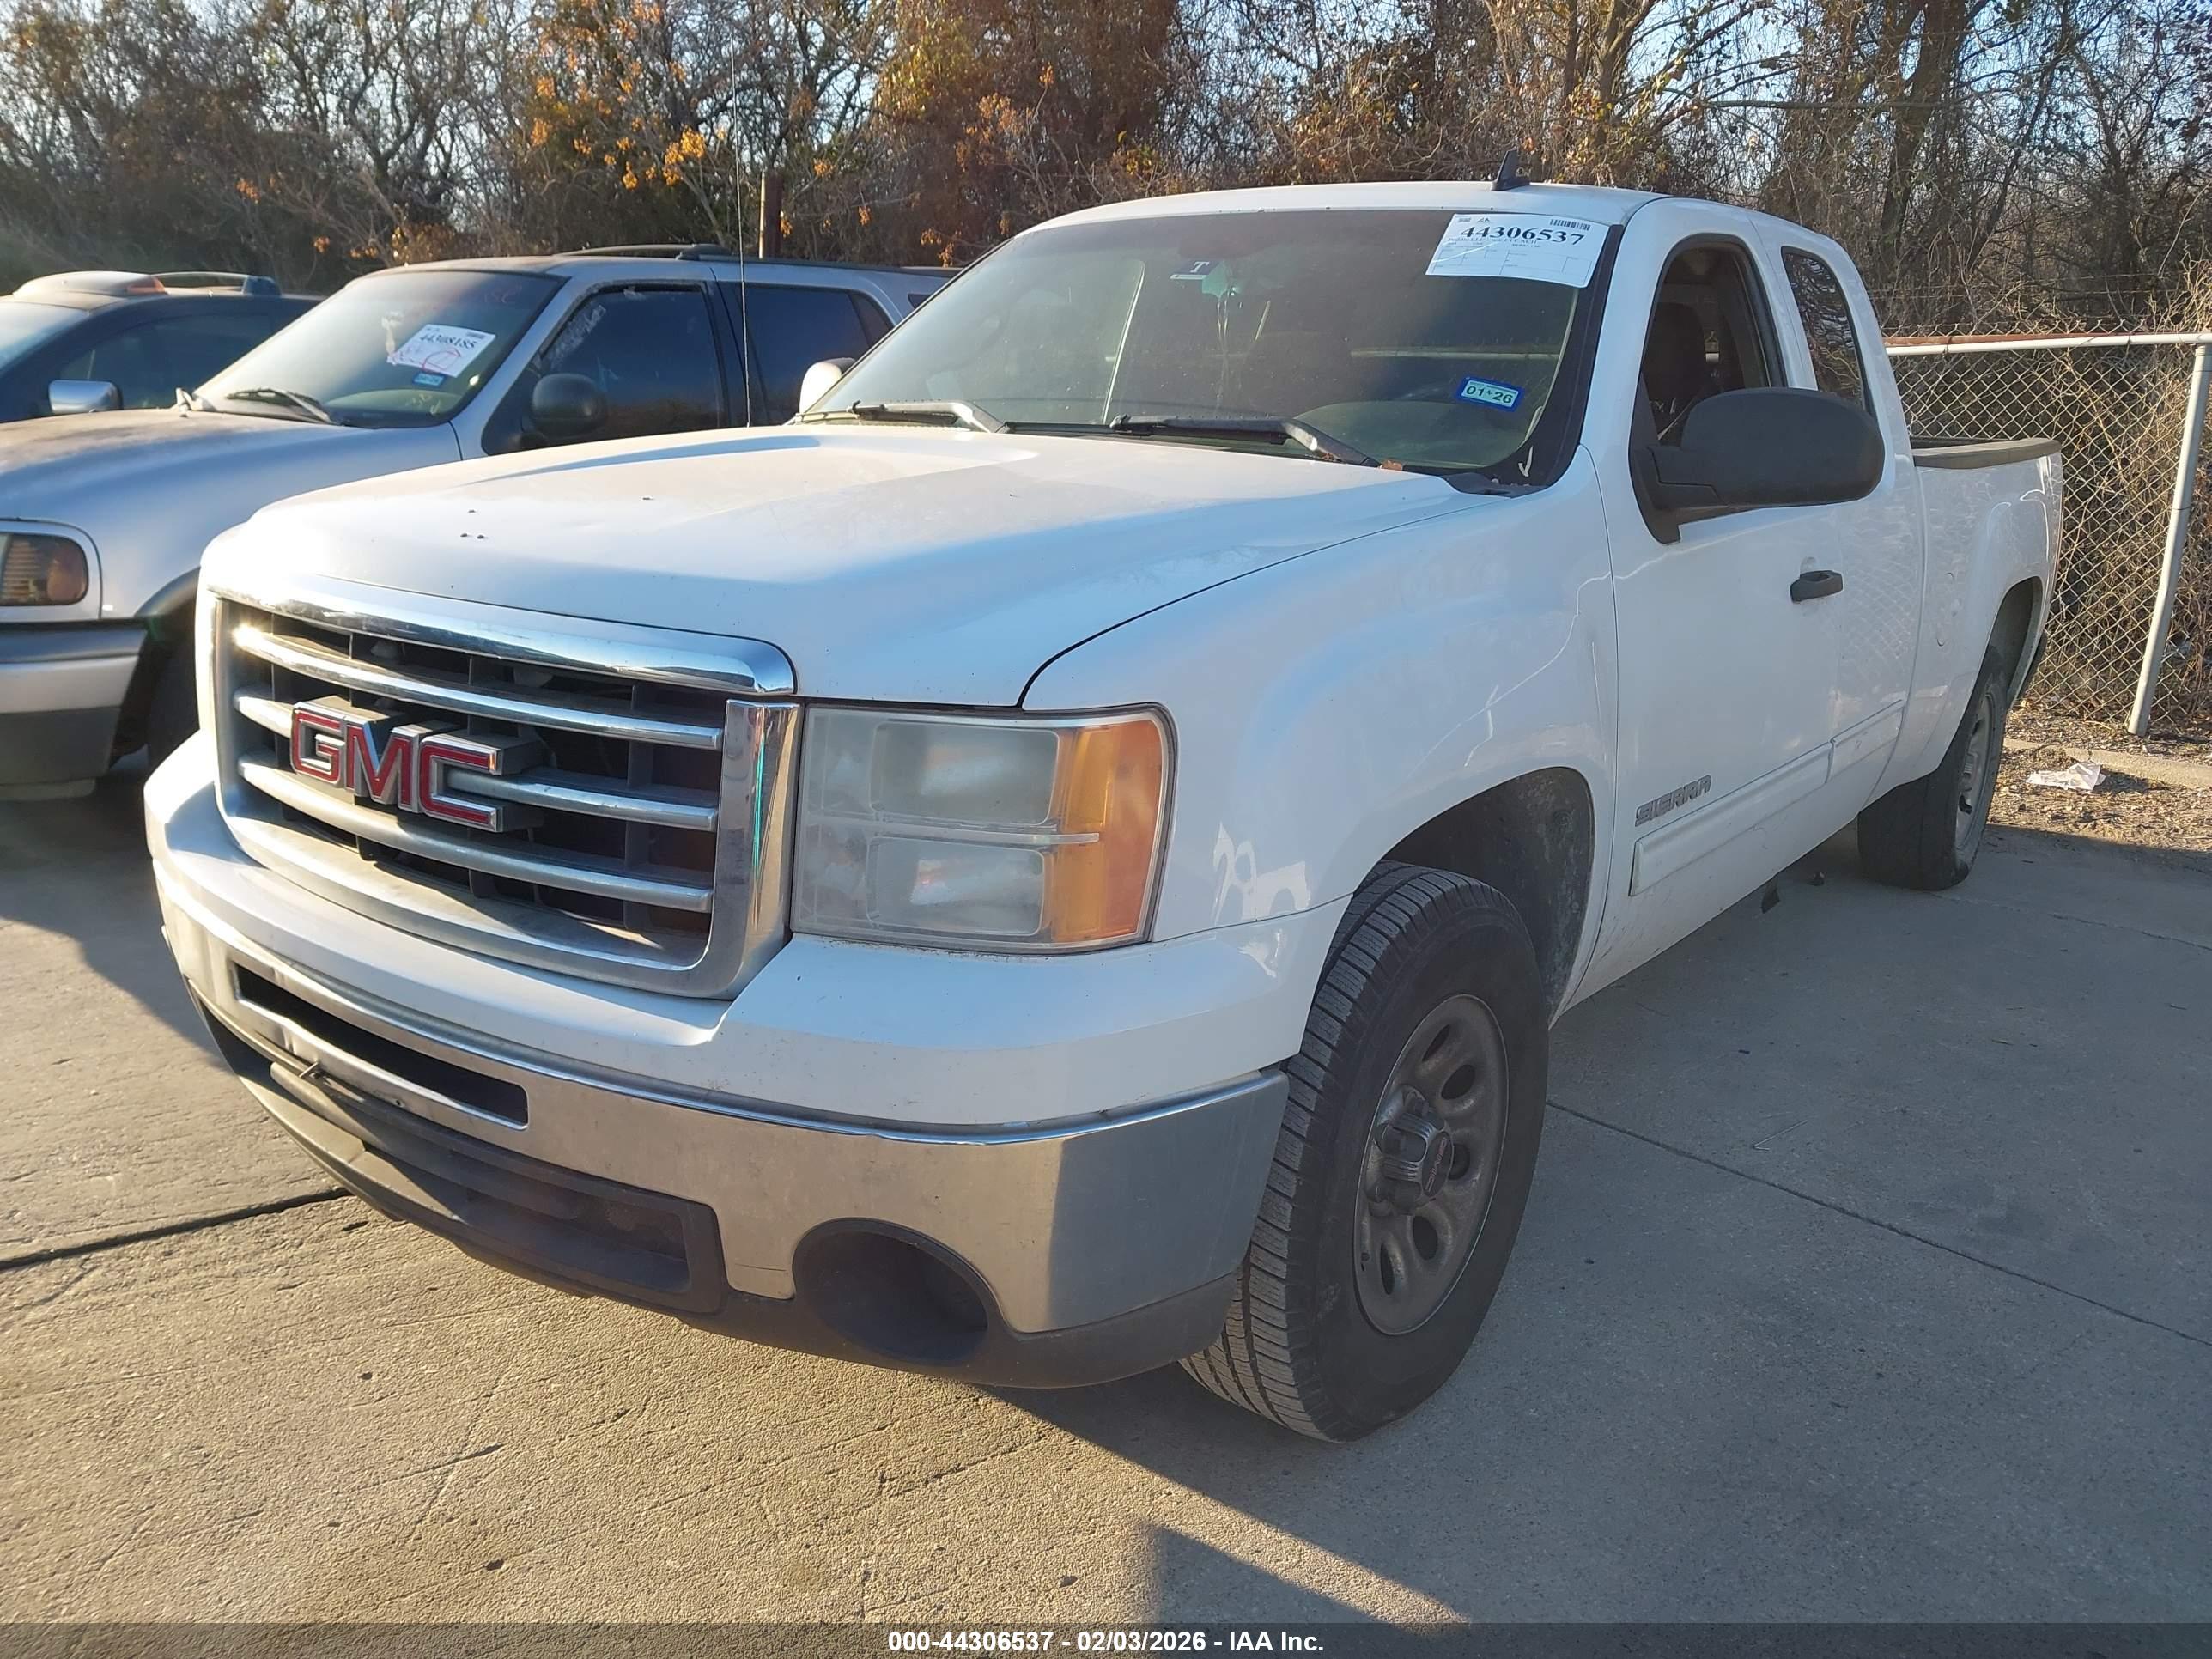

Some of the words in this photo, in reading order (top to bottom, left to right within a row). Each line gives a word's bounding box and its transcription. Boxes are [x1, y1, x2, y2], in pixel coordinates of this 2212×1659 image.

[1460, 226, 1584, 246] 44306537
[291, 702, 501, 833] GMC
[1635, 775, 1711, 827] SIERRA
